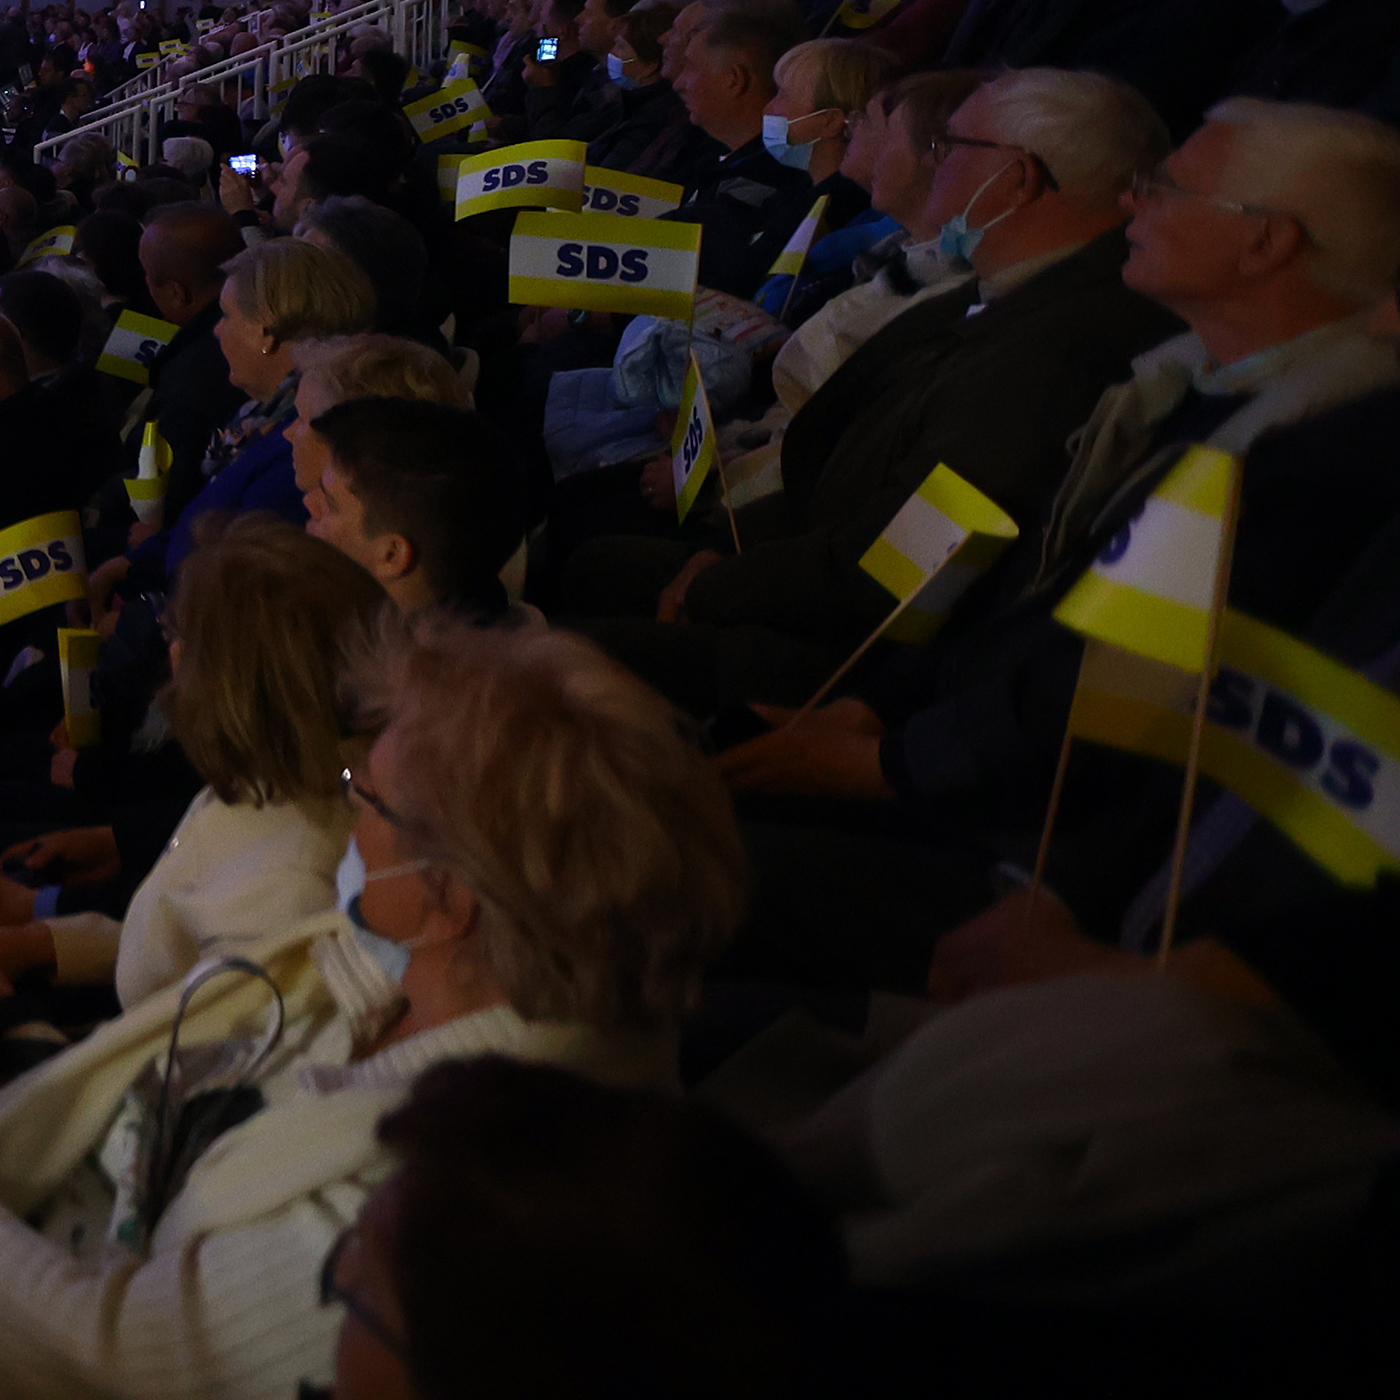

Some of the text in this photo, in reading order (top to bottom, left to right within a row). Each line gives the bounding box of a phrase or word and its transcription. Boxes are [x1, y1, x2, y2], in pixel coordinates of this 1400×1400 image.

[429, 97, 469, 124] SDS
[482, 160, 549, 192] SDS
[555, 242, 649, 282] SDS
[682, 404, 704, 476] SDS
